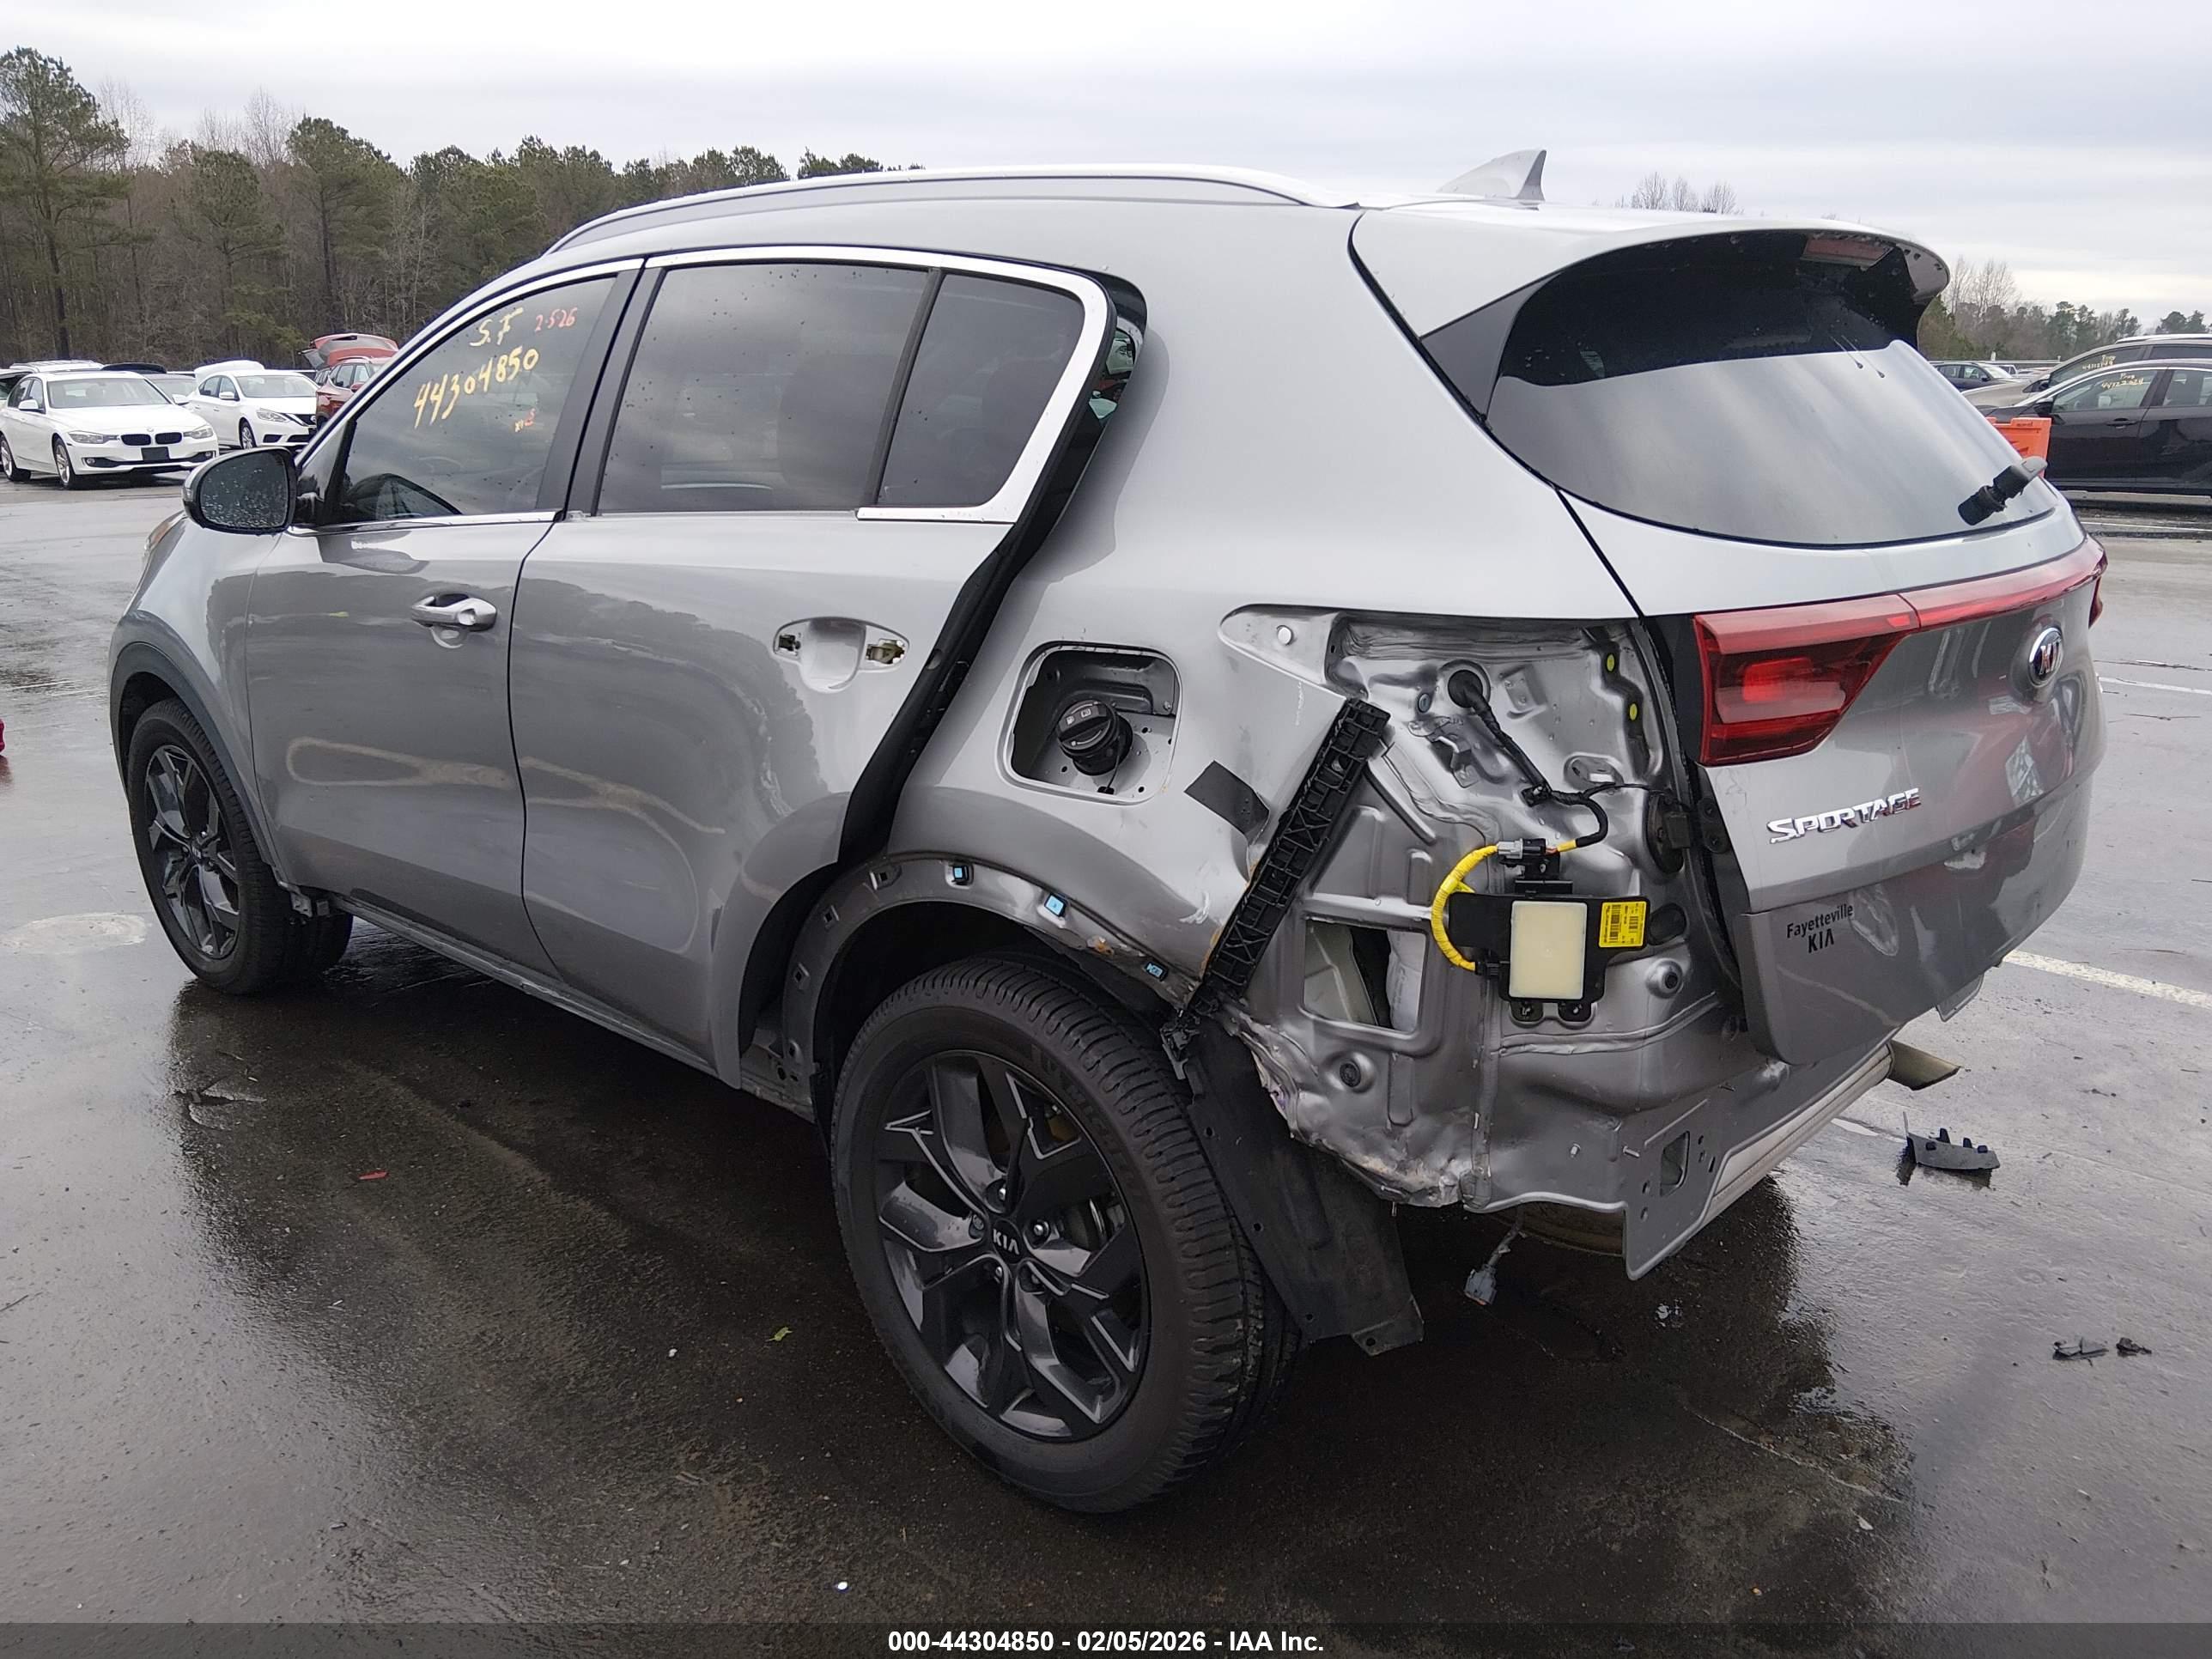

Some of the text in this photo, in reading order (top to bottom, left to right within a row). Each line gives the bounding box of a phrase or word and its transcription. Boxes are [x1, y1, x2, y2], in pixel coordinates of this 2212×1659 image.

[413, 345, 540, 430] 44304850
[1766, 787, 1922, 845] SPORTAGE
[1786, 902, 1854, 939] Fayetteville
[1808, 927, 1835, 954] KIA
[993, 1228, 1020, 1255] KIA
